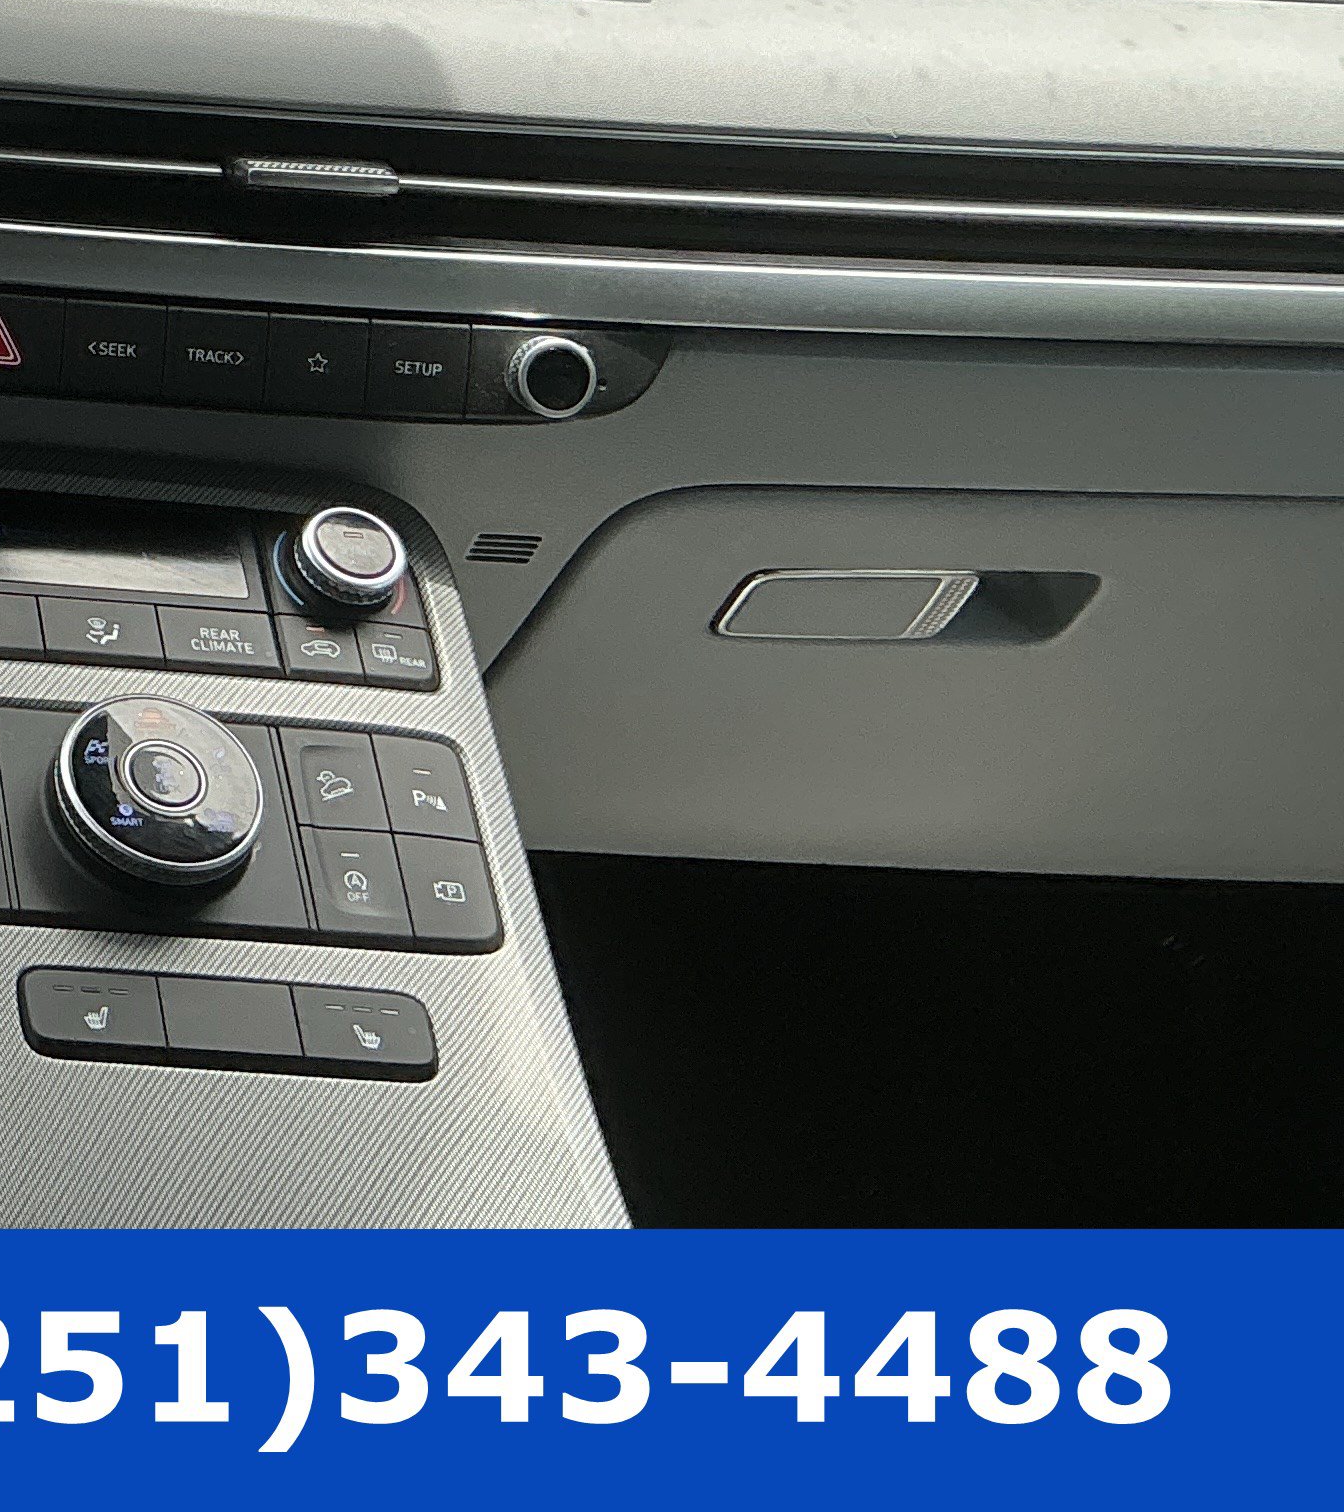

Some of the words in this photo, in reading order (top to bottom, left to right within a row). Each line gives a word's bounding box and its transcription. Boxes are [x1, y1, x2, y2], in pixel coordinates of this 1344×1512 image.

[393, 359, 443, 378] SETUP
[198, 626, 242, 642] REAR
[190, 636, 255, 657] CLIMATE
[398, 655, 428, 670] REAR
[109, 816, 144, 827] SMART
[346, 890, 370, 902] OFF
